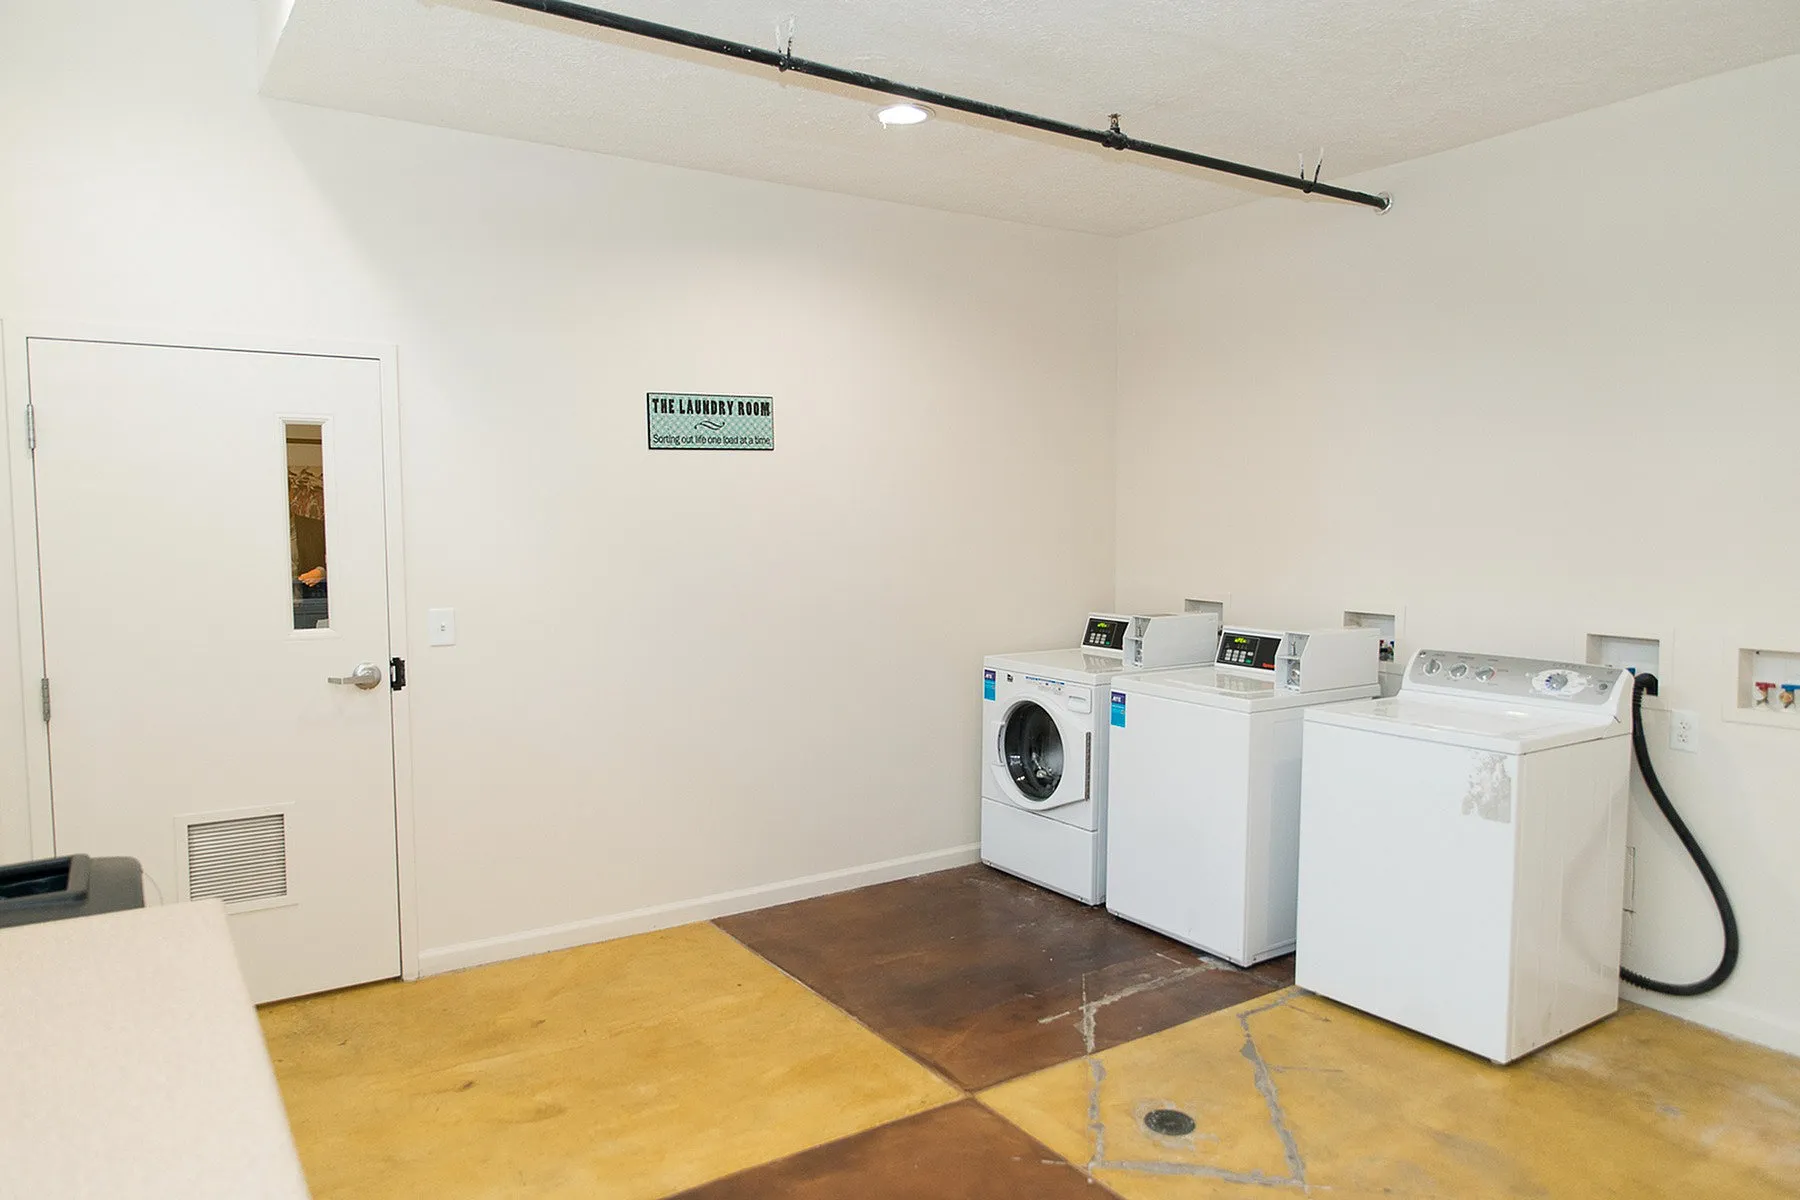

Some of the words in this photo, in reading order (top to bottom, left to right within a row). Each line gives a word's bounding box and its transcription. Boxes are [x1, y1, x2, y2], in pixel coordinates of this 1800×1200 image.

[652, 398, 675, 414] THE
[679, 400, 734, 415] LAUNDRY
[738, 401, 770, 416] ROOM
[653, 434, 680, 446] Sorting
[682, 435, 694, 444] out
[695, 435, 707, 444] life
[723, 436, 738, 444] load
[740, 436, 747, 445] at
[755, 436, 770, 445] time
